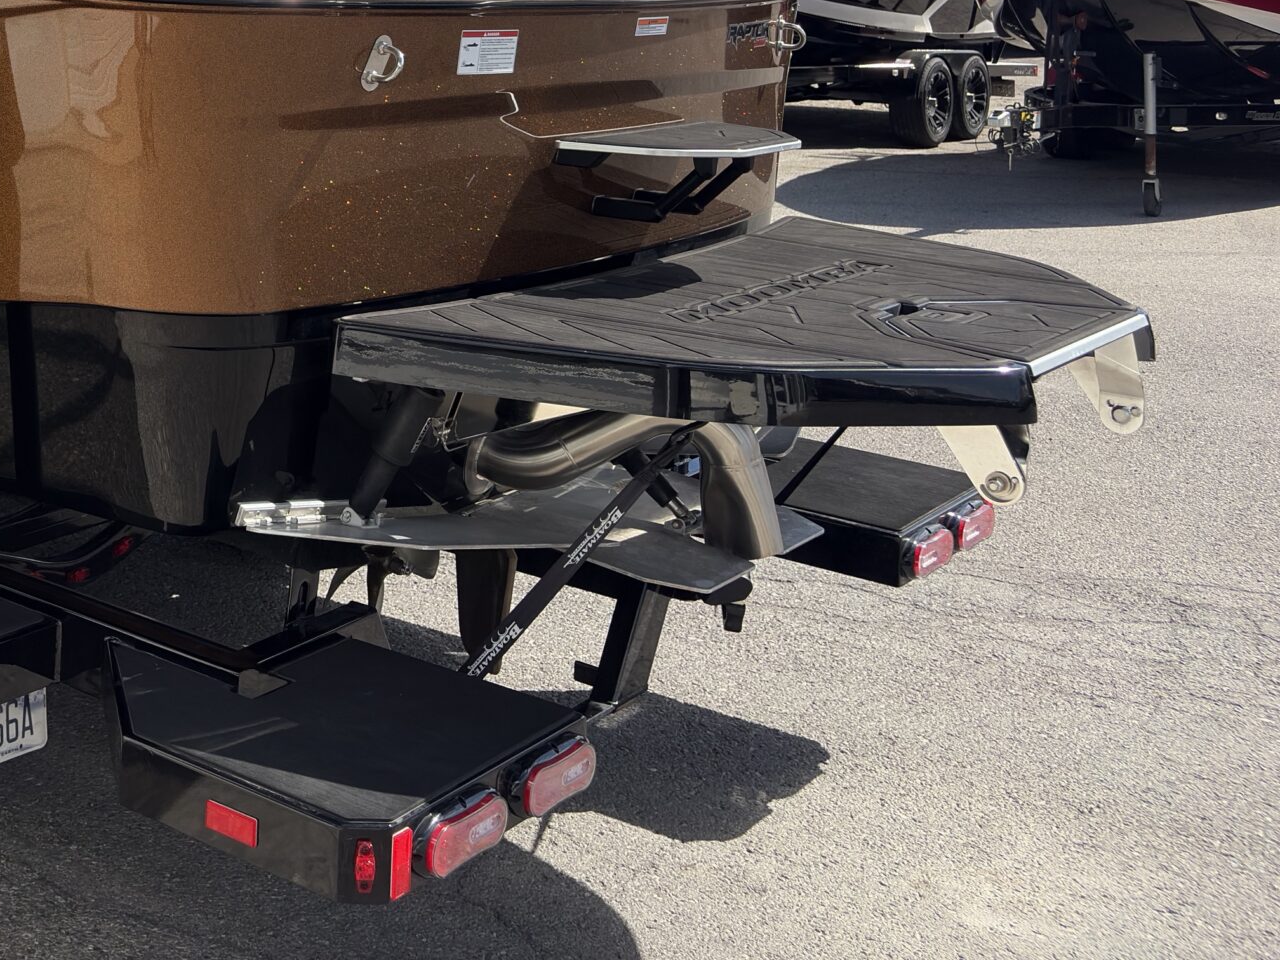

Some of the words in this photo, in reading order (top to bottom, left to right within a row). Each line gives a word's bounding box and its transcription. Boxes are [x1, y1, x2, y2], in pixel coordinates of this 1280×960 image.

[664, 259, 893, 323] MOOMBA
[568, 509, 625, 565] BOATMATE
[469, 623, 524, 677] BOATMATE
